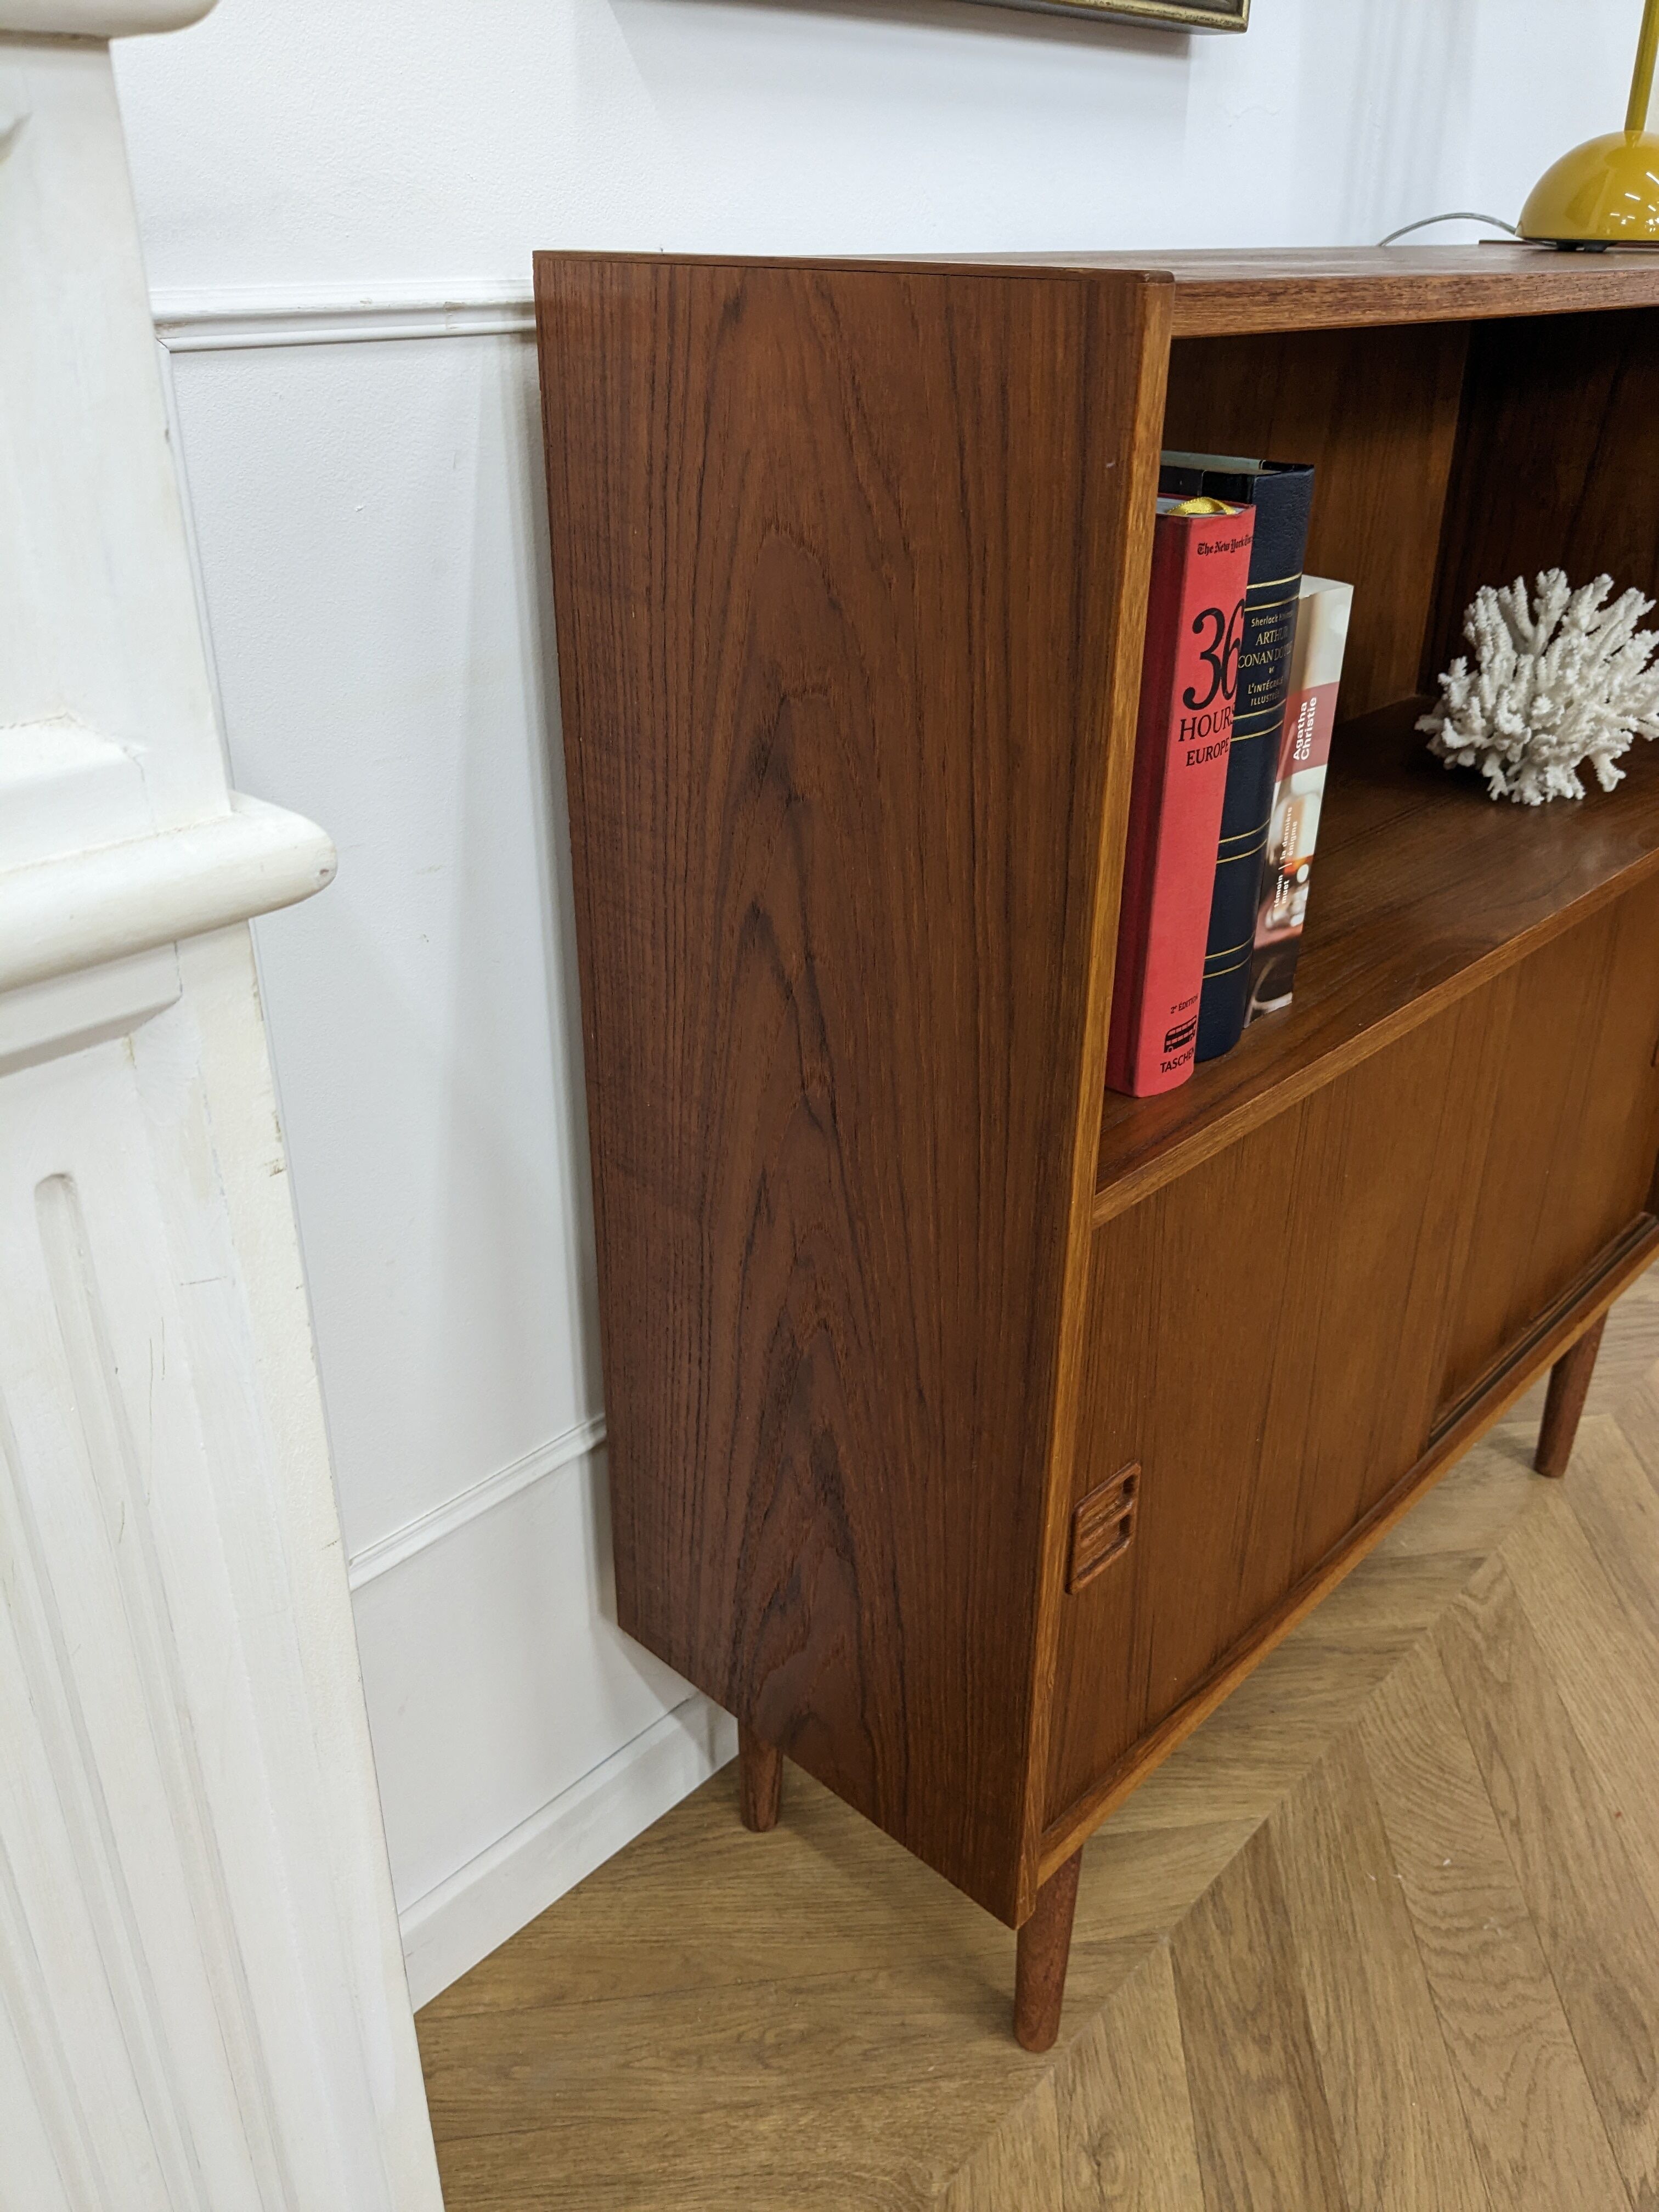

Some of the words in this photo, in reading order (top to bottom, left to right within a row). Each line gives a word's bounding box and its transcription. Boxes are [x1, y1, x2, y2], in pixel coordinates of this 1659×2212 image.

[1197, 543, 1214, 556] The
[1214, 540, 1230, 554] New
[1230, 537, 1244, 553] York
[1251, 614, 1278, 628] Sherlock
[1183, 599, 1245, 710] 36
[1238, 648, 1274, 668] CONAN
[1293, 702, 1307, 760] Agatha
[1301, 697, 1317, 760] Christie
[1186, 737, 1230, 766] EUROPE
[1282, 807, 1293, 847] dernière
[1288, 821, 1298, 856] énigme
[1280, 850, 1286, 861] la
[1274, 874, 1283, 908] témoin
[1282, 879, 1290, 904] muet
[1178, 993, 1198, 1011] ÉDITION
[1160, 1047, 1194, 1073] TASCHEN
